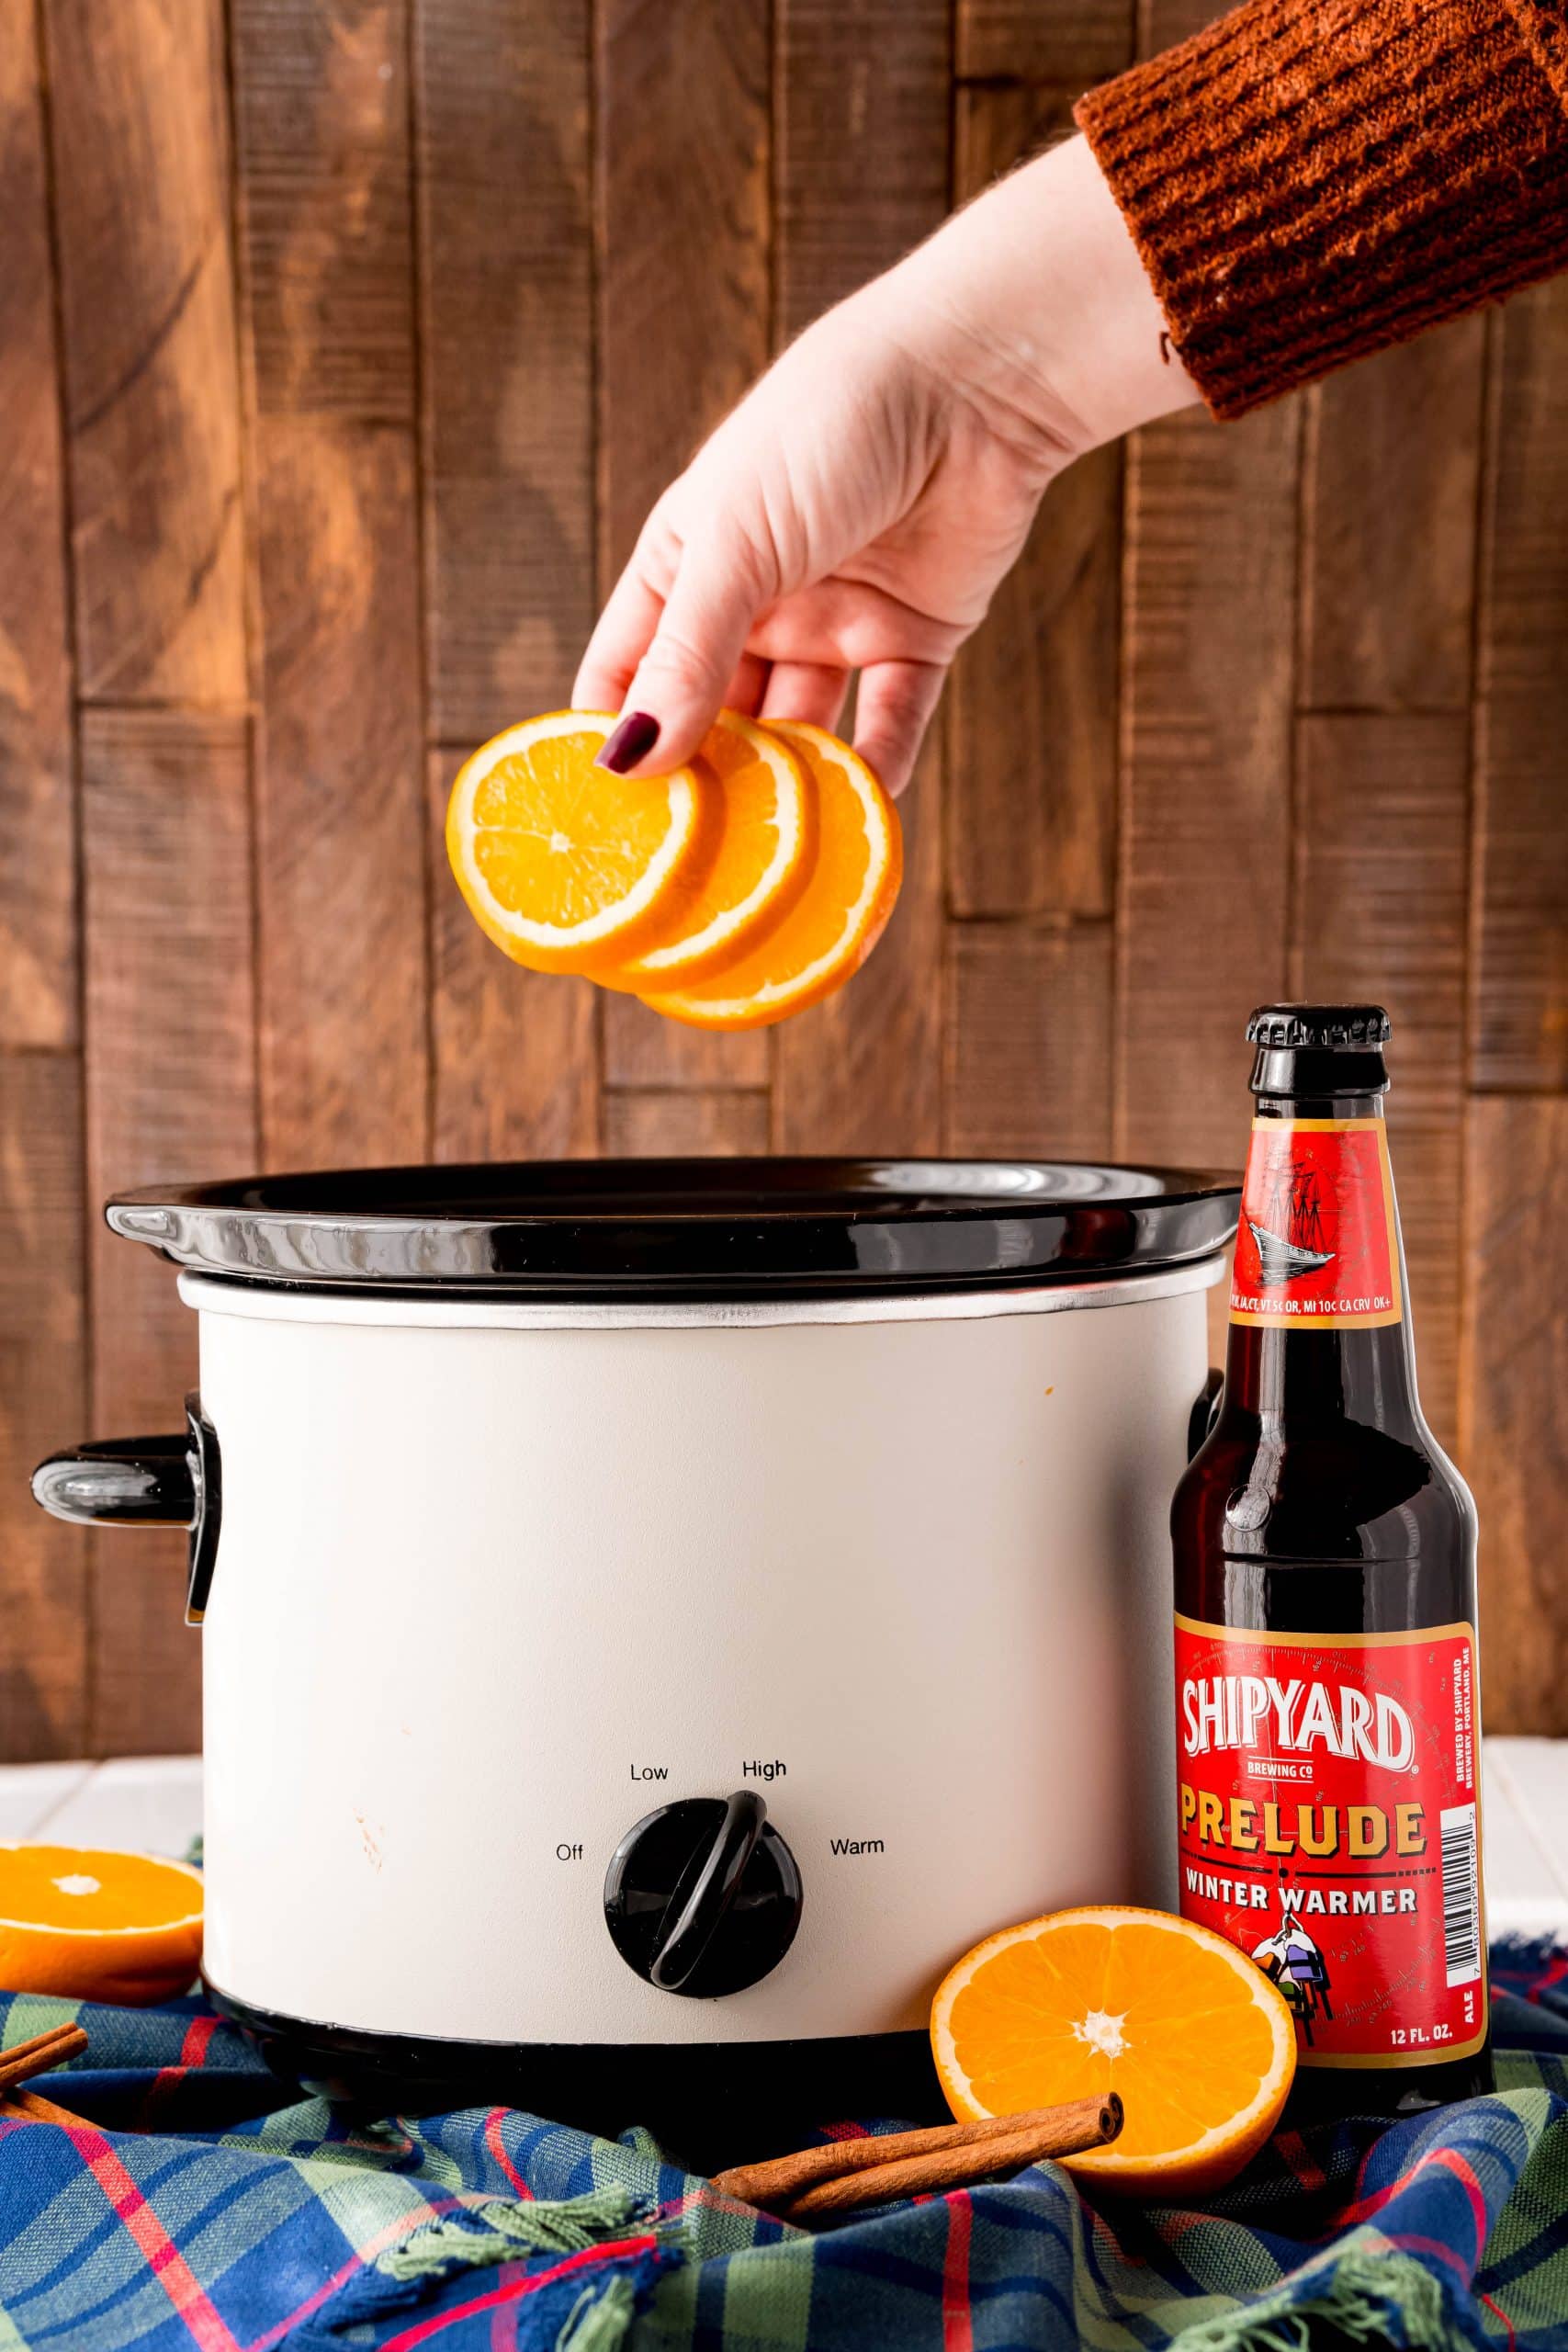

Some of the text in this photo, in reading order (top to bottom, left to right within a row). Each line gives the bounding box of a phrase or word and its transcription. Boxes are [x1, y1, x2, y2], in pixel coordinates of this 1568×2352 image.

[1260, 1298, 1271, 1311] VT
[1286, 1300, 1302, 1314] OR,
[1303, 1301, 1316, 1313] MI
[1339, 1300, 1352, 1312] CA
[1353, 1298, 1371, 1311] CRV
[1182, 1676, 1415, 1774] SHIPYARD
[1453, 1658, 1464, 1782] BREWED BY SHIPYARD
[1462, 1646, 1473, 1789] BREWERY, PORTLAND, ME
[630, 1763, 669, 1781] Low
[742, 1759, 786, 1781] High
[1247, 1761, 1297, 1778] BREWING
[1180, 1782, 1427, 1860] PRELUDE
[1469, 1810, 1475, 1821] 2
[556, 1843, 584, 1860] Off
[830, 1838, 886, 1855] Warm
[1186, 1866, 1417, 1915] WINTER WARMER
[1473, 1967, 1482, 1977] 7
[1464, 1990, 1474, 2024] ALE
[1391, 2023, 1453, 2045] 12 FL. OZ.
